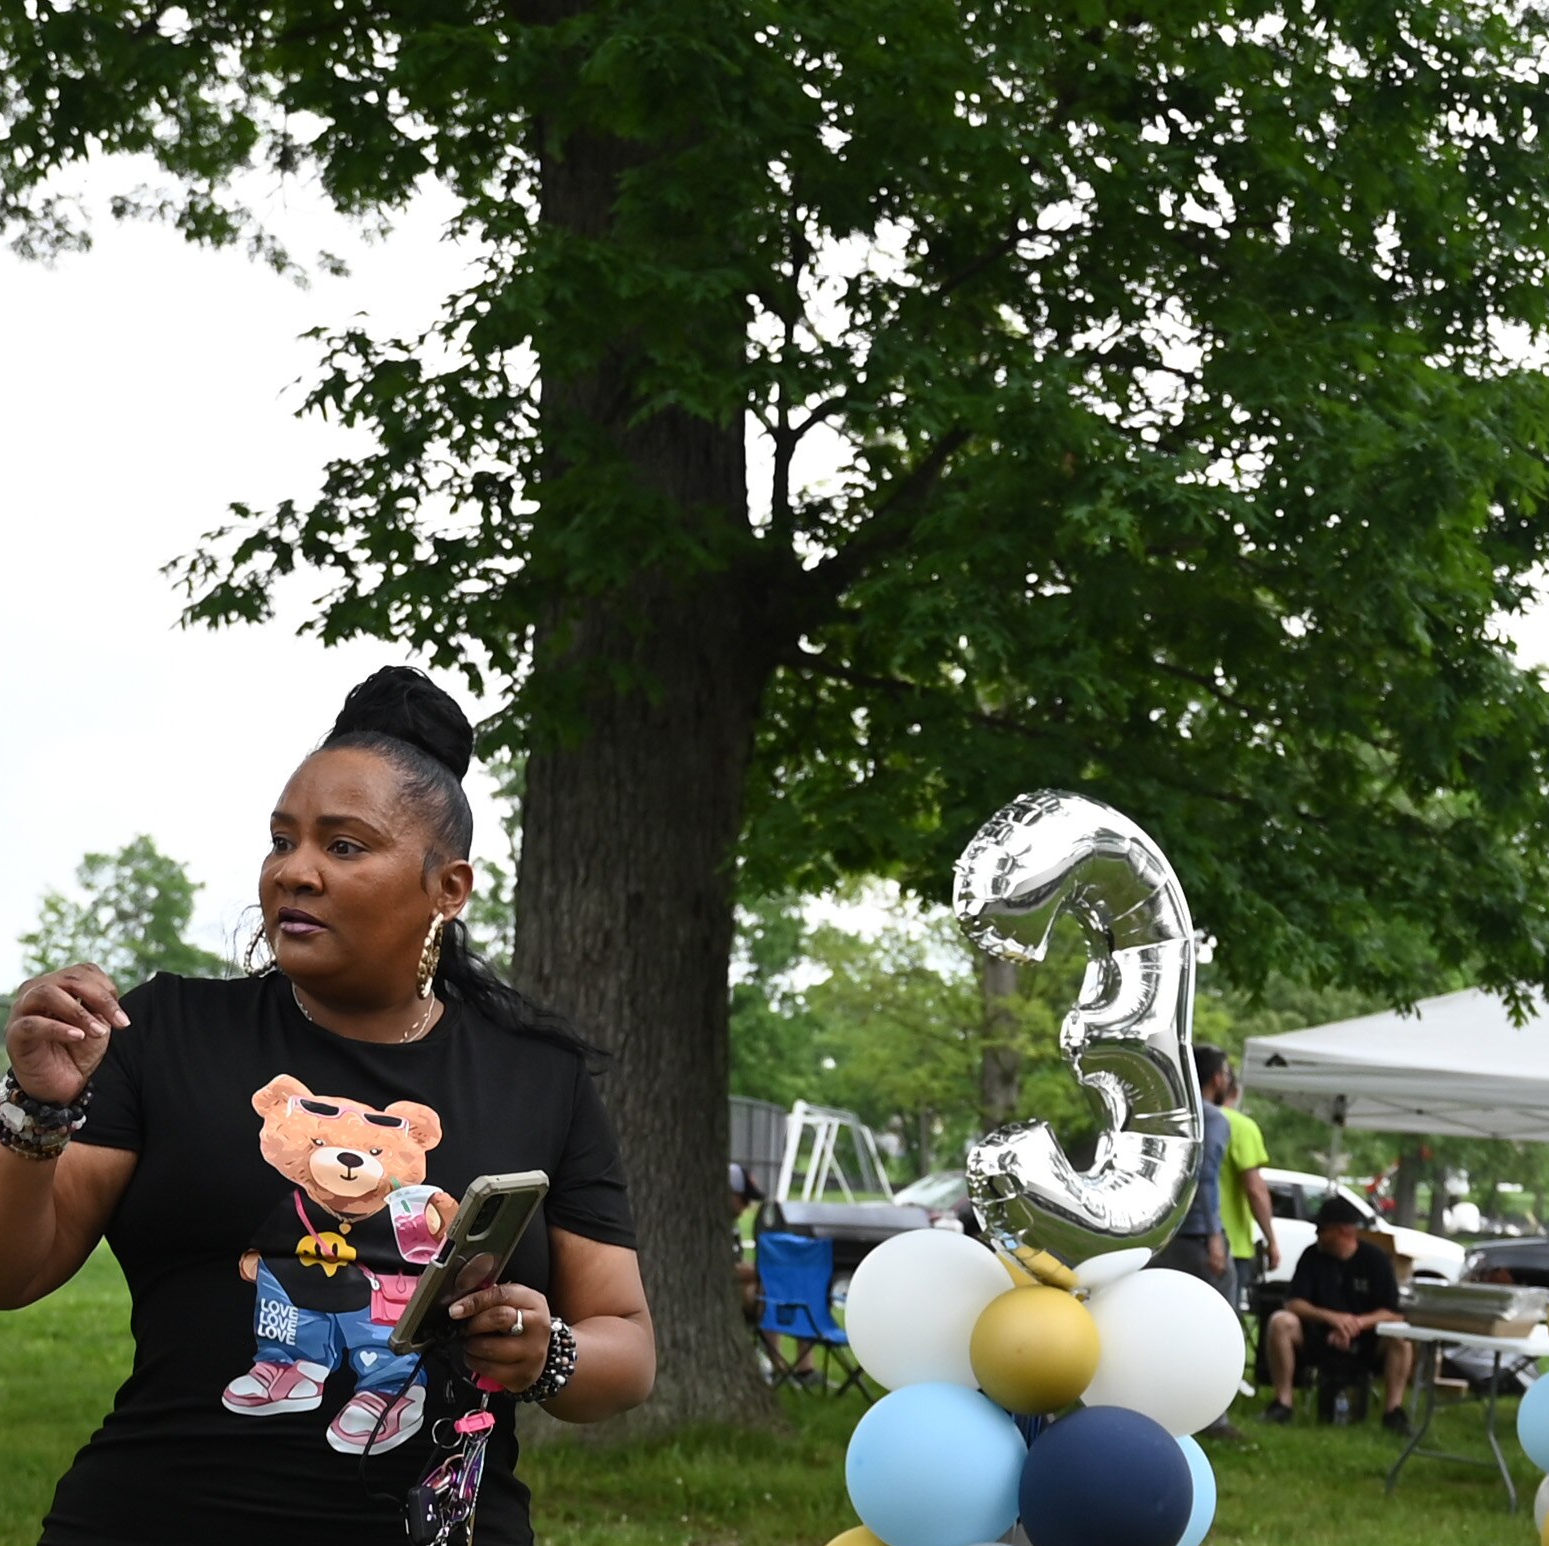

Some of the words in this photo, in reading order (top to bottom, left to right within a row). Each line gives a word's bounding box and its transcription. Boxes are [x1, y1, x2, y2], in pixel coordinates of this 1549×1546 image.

[953, 788, 1204, 1280] 3
[261, 1298, 299, 1320] LOVE
[259, 1311, 298, 1333] LOVE
[257, 1323, 297, 1346] LOVE
